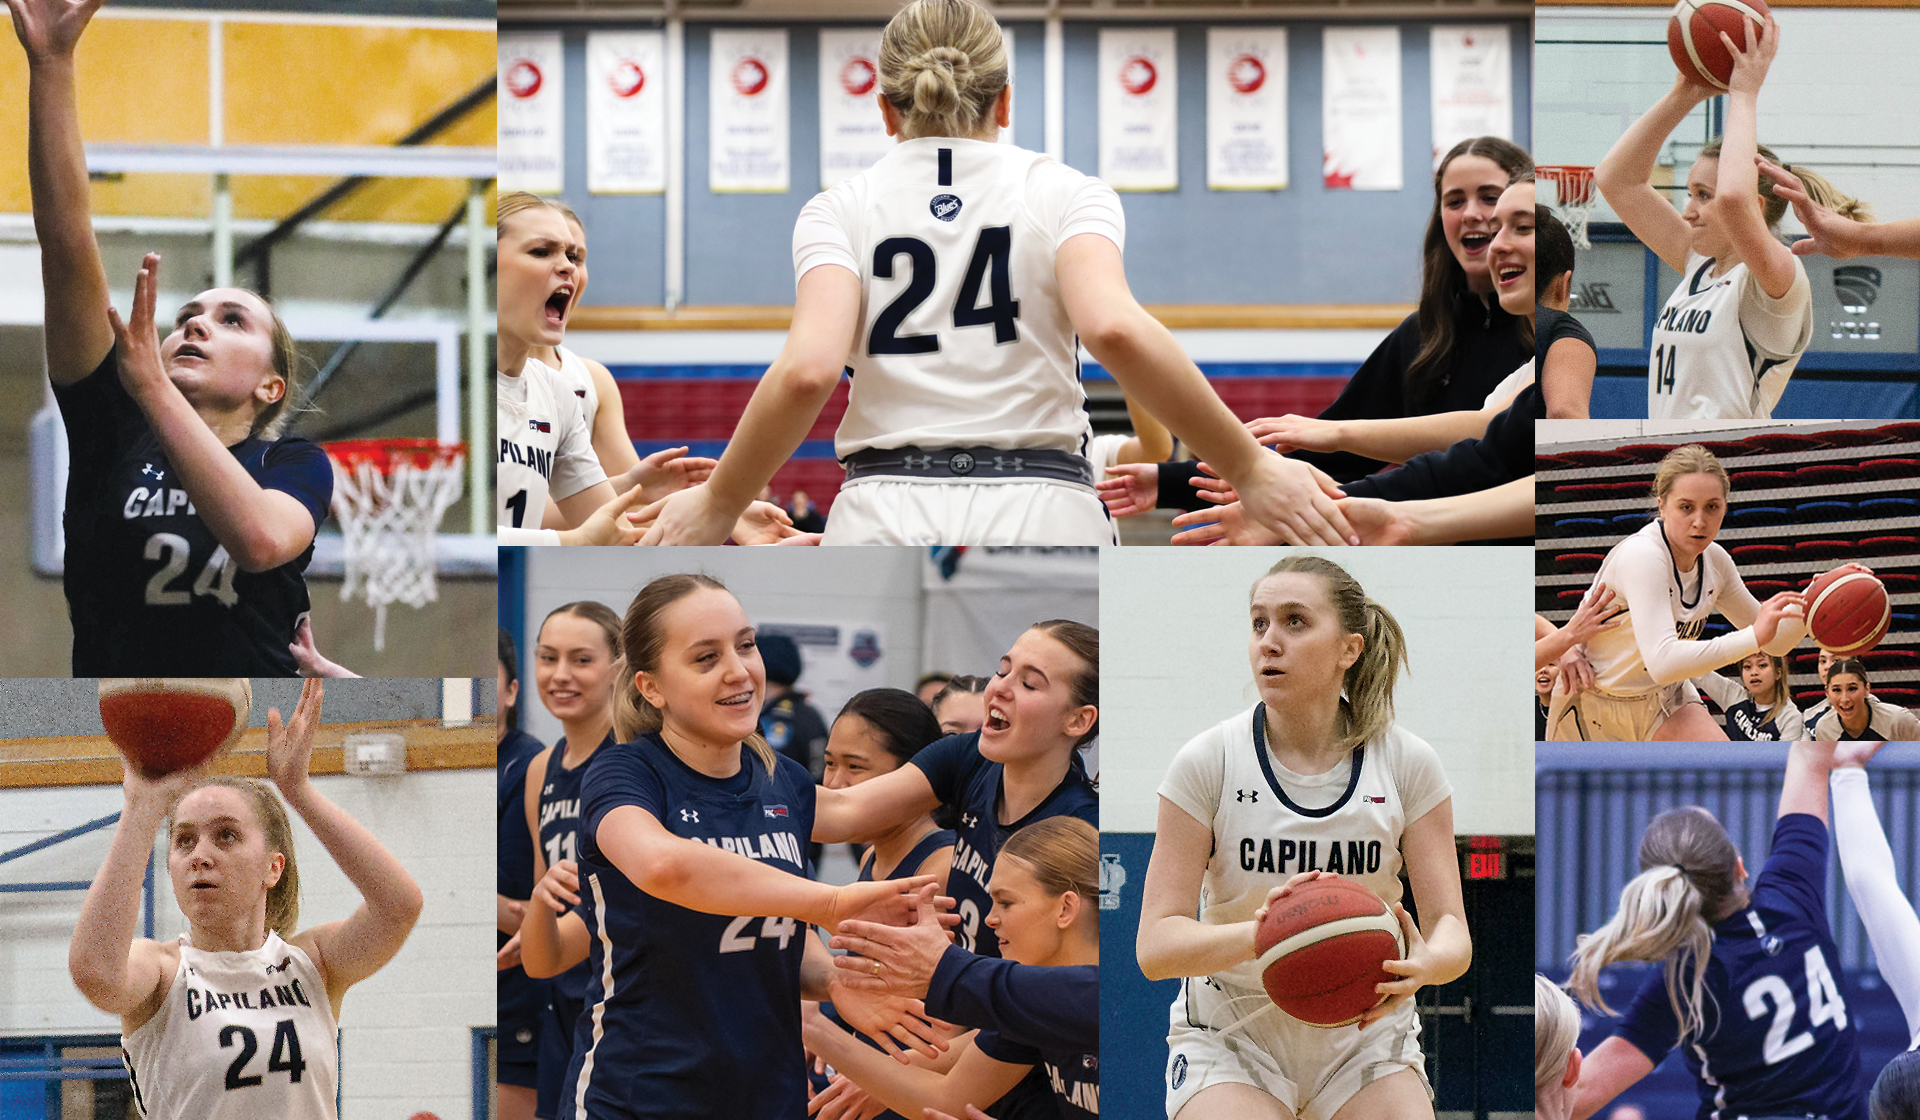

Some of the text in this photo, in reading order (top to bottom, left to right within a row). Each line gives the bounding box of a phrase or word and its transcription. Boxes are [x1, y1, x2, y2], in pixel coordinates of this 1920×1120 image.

[935, 198, 958, 217] Blues
[867, 224, 1020, 358] 24
[1654, 306, 1712, 334] PILANO
[1655, 343, 1676, 395] 14
[143, 532, 239, 609] 24
[545, 830, 576, 867] 11
[1239, 837, 1382, 875] CAPILANO
[1470, 852, 1501, 878] EXIT
[187, 977, 311, 1021] CAPILANO
[1743, 944, 1847, 1066] 24
[218, 1018, 306, 1091] 24
